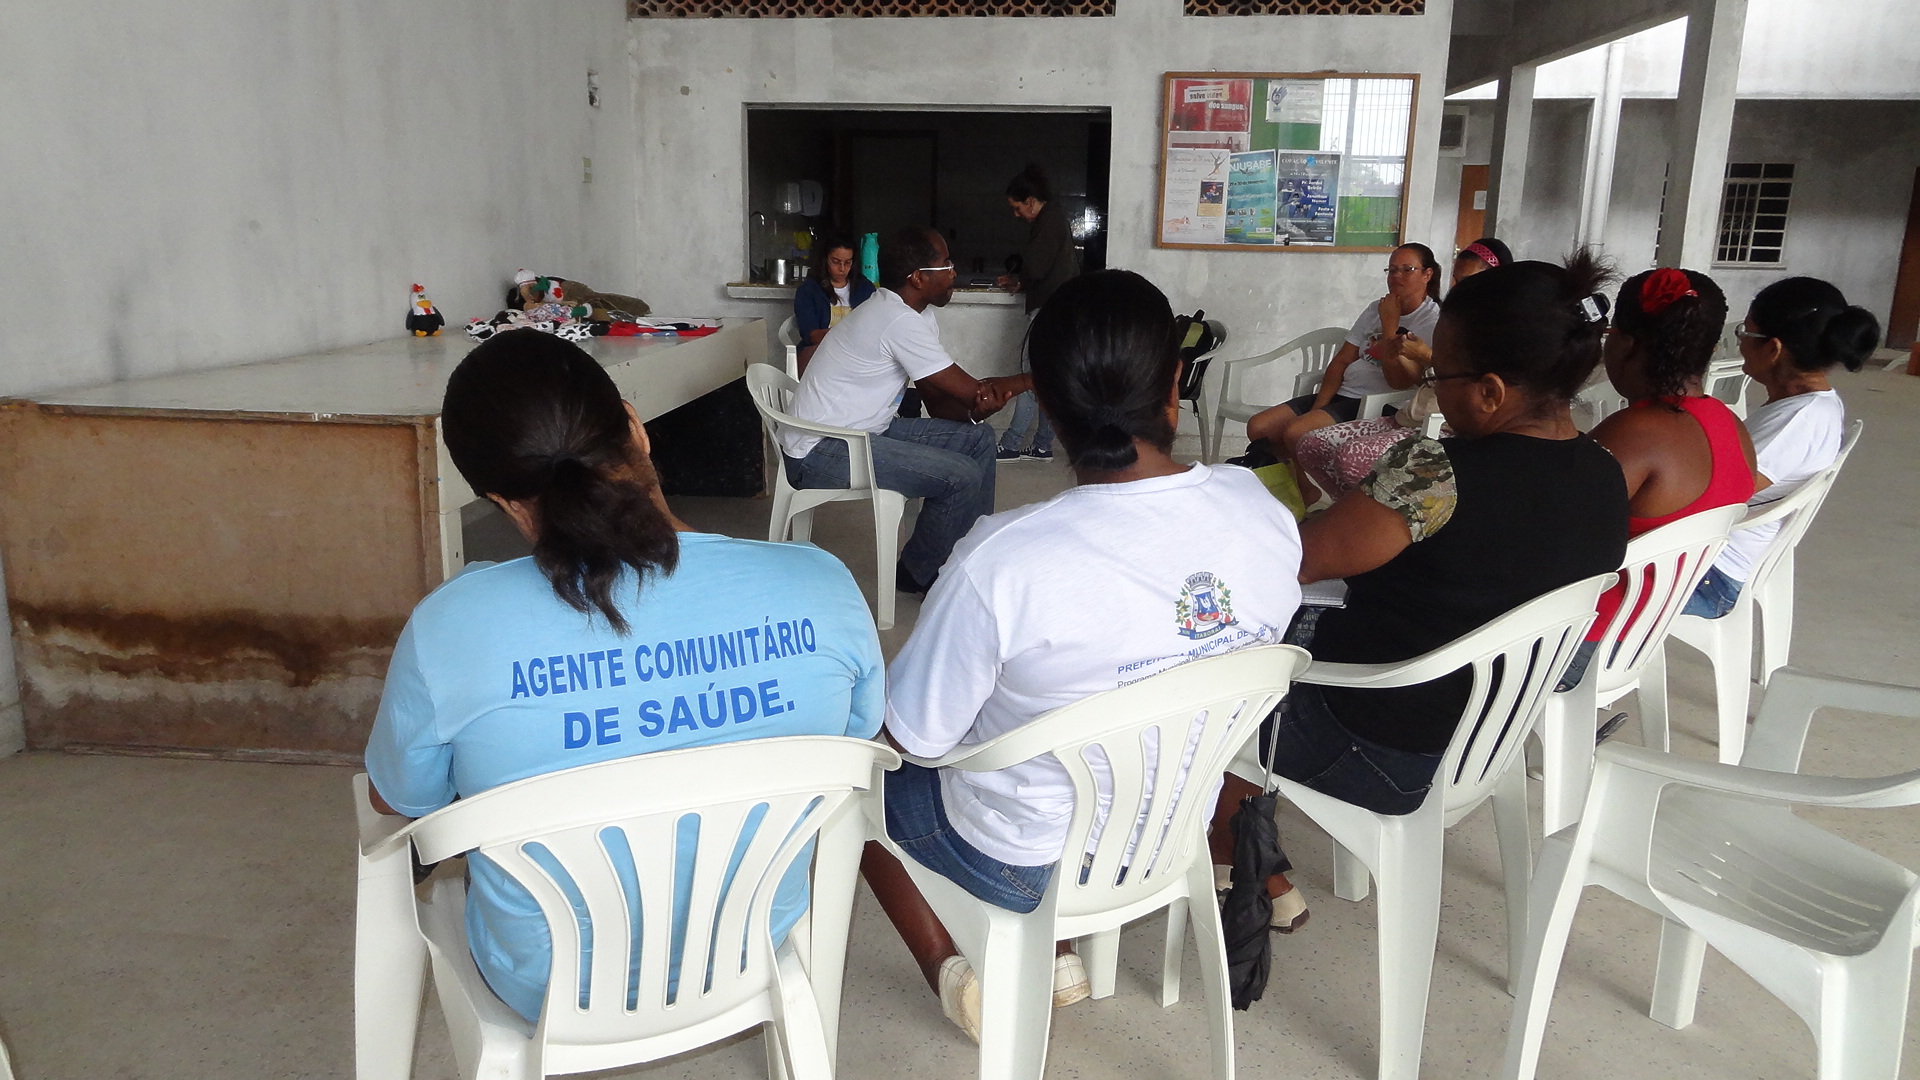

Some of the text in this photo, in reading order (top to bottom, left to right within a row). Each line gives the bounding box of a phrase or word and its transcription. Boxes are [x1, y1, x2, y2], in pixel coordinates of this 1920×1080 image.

[511, 615, 817, 699] AGENTE COMUNITÁRIO
[1188, 634, 1235, 656] MUNICIPAL
[563, 678, 795, 750] DE SAÚDE.
